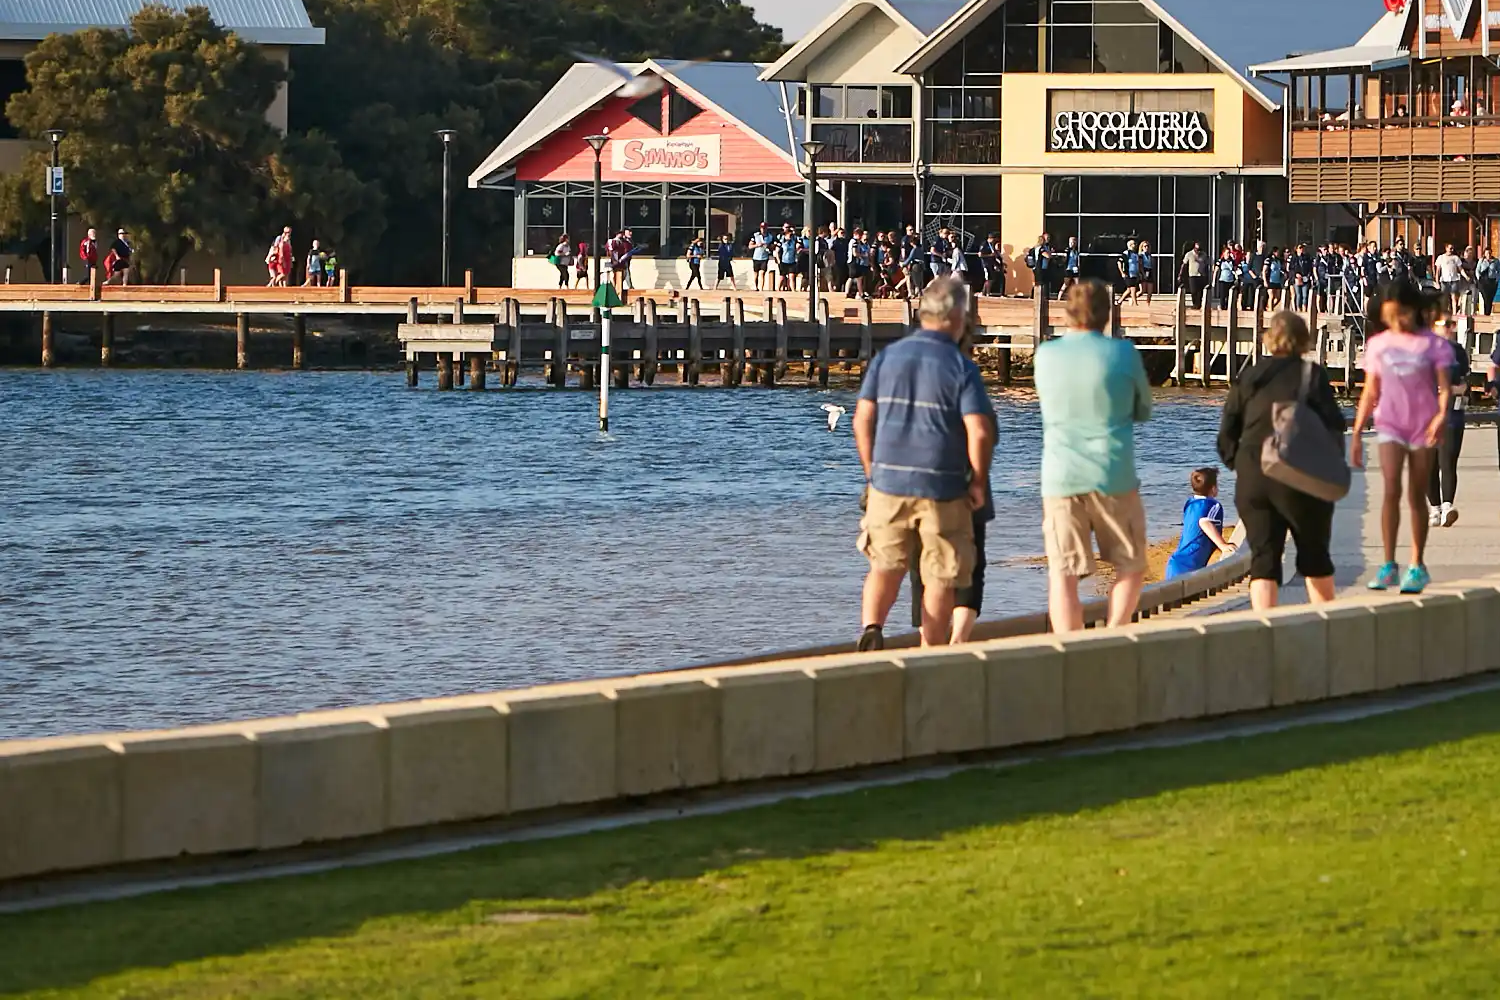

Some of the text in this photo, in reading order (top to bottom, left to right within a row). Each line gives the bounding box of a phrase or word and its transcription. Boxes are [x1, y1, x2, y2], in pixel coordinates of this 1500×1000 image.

[1055, 111, 1201, 131] CHOCOLATERIA
[1051, 128, 1208, 150] SAN CHURRO
